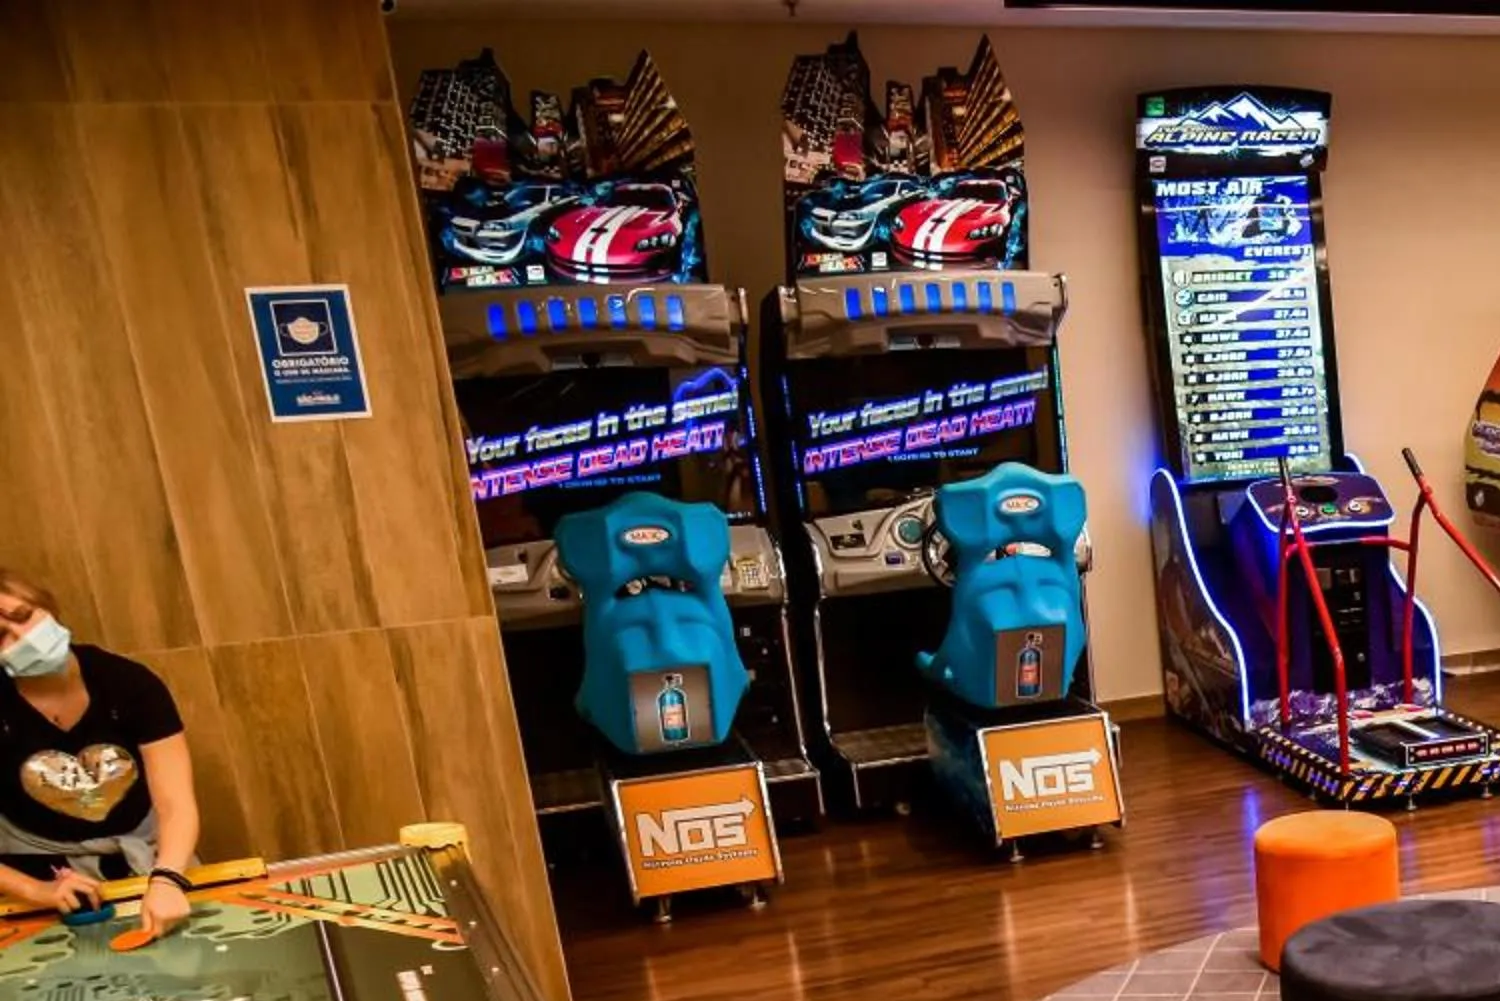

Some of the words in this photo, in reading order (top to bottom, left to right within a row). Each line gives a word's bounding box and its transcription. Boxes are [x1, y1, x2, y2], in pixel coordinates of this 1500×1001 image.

[1150, 131, 1236, 143] ALPINE
[1240, 130, 1319, 142] RACER
[1156, 181, 1219, 197] MOST
[1225, 181, 1263, 195] AIR
[1244, 245, 1313, 257] EVEREST
[272, 356, 349, 368] OBRIGATÓRIO
[466, 434, 520, 463] Your
[526, 421, 592, 451] faces
[597, 413, 618, 437] in
[625, 404, 667, 430] the
[808, 410, 856, 437] Your
[860, 395, 921, 426] faces
[923, 388, 943, 412] in
[948, 383, 986, 406] the
[470, 455, 573, 499] NTENSE
[578, 439, 648, 478] DEAD
[803, 431, 901, 475] INTENSE
[905, 415, 967, 450] DEAD
[1000, 750, 1101, 800] NOS
[636, 800, 753, 857] NOS
